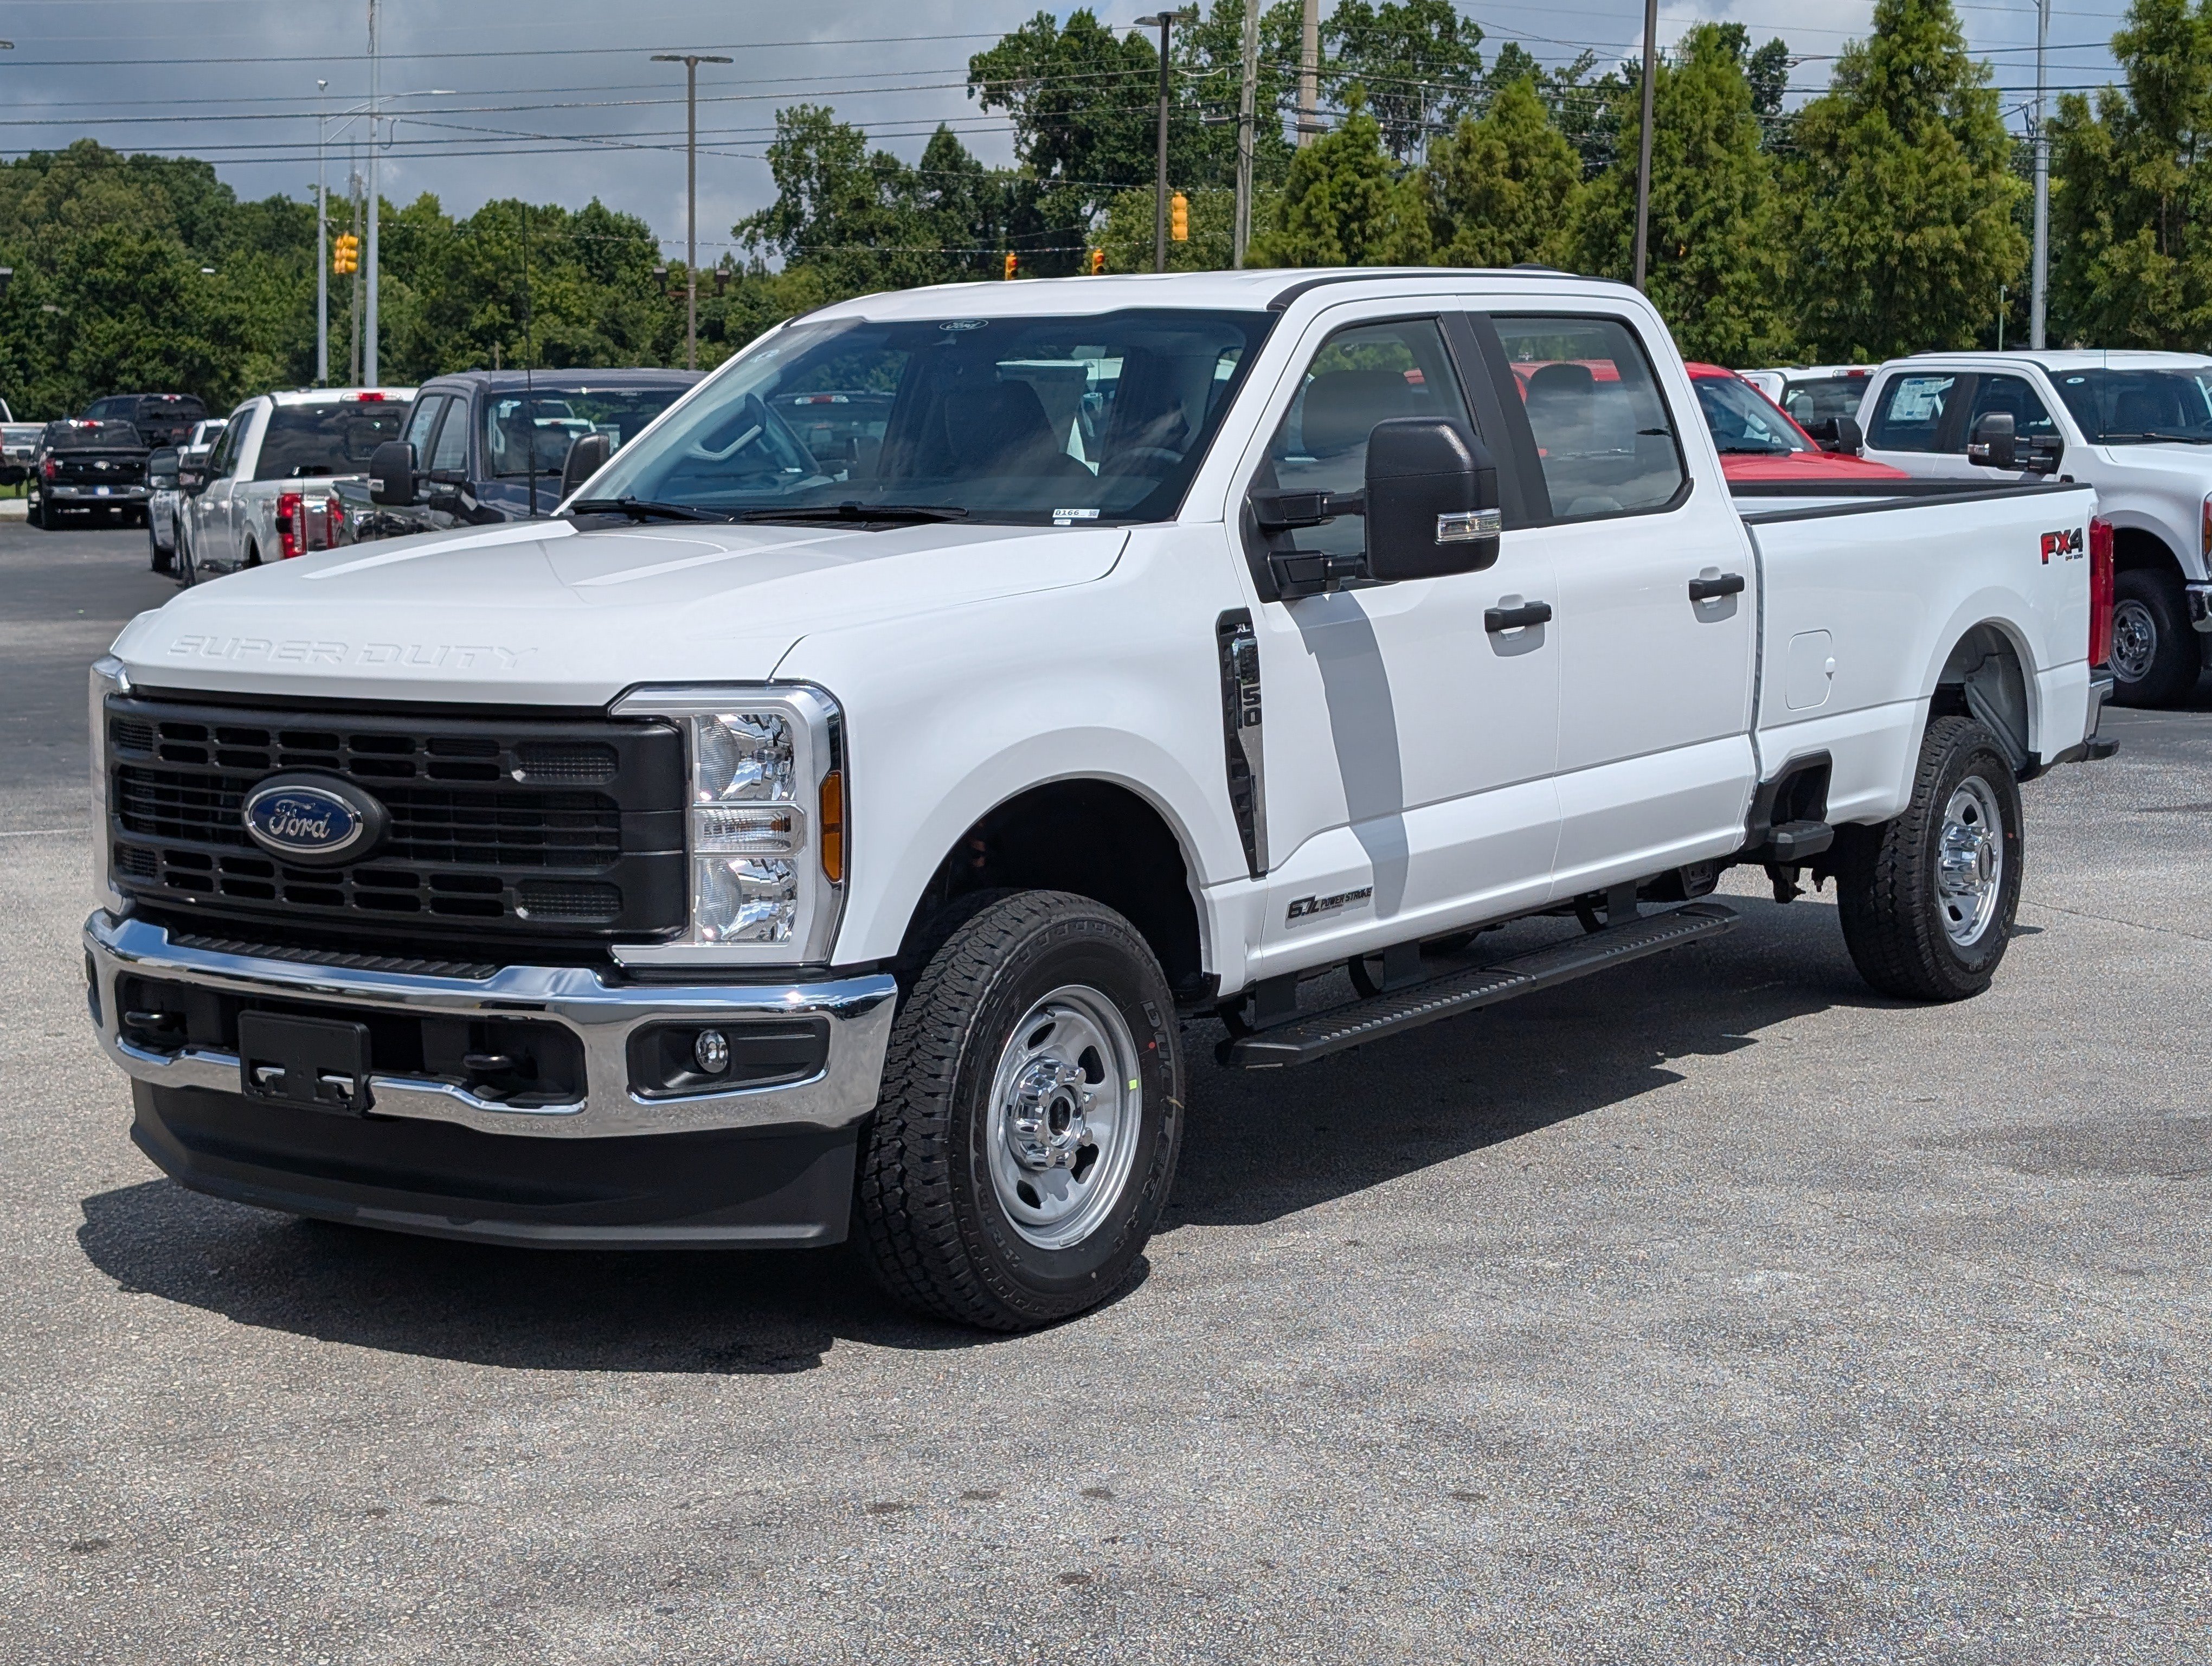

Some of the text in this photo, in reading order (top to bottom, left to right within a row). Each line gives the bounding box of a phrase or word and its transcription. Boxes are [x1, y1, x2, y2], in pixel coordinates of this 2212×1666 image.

[946, 320, 981, 330] Ford
[2040, 527, 2084, 565] FX4
[1235, 623, 1251, 633] XL
[168, 635, 539, 669] SUPER DUTY
[269, 799, 331, 838] Ford
[1287, 895, 1320, 919] 6.7L
[1321, 895, 1345, 907] POWER
